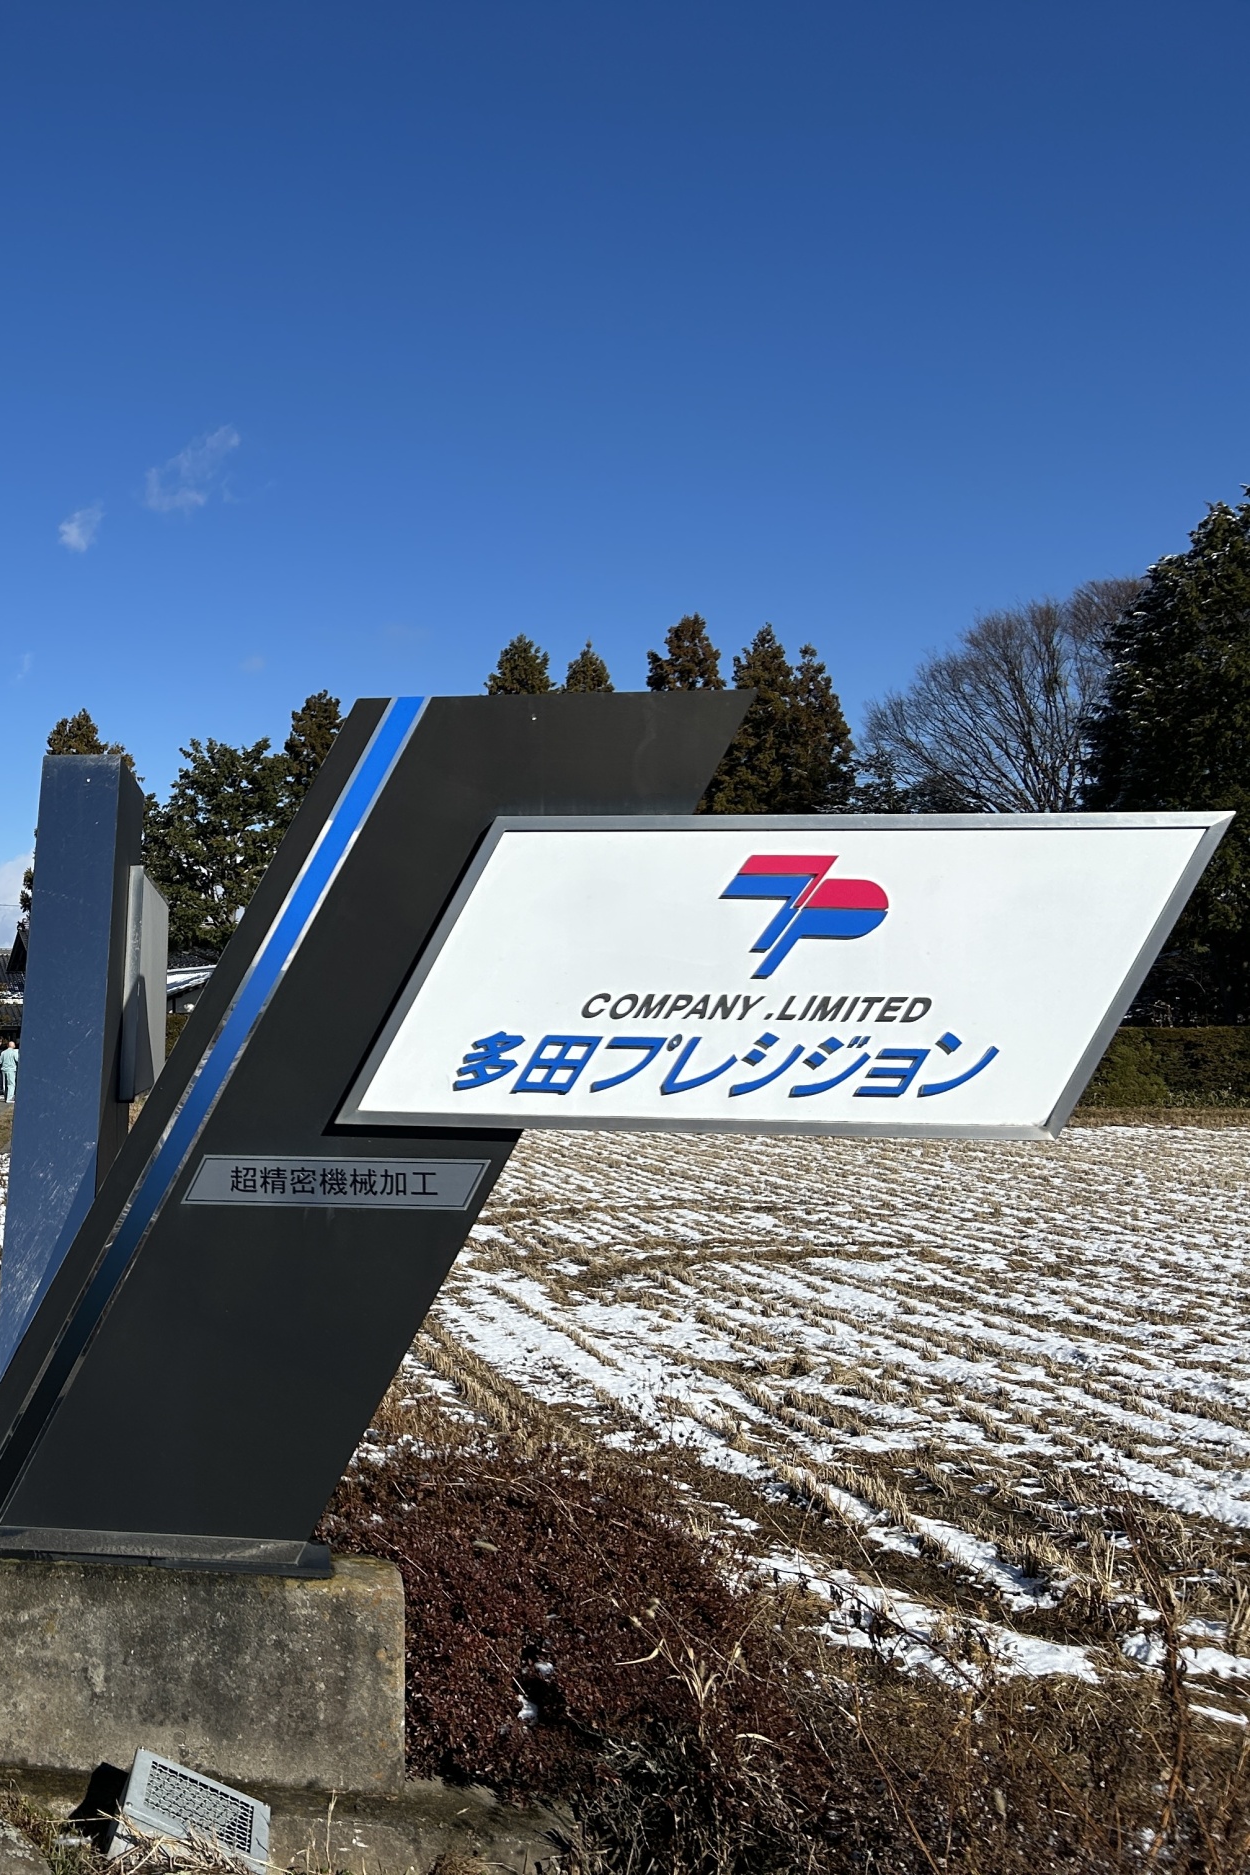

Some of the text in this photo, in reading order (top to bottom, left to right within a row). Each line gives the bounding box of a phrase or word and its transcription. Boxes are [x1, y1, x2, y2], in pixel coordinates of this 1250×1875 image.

[580, 992, 766, 1021] COMPANY
[452, 1030, 1000, 1099] 多田プレシジョン
[229, 1165, 439, 1197] 超精密機械加工
